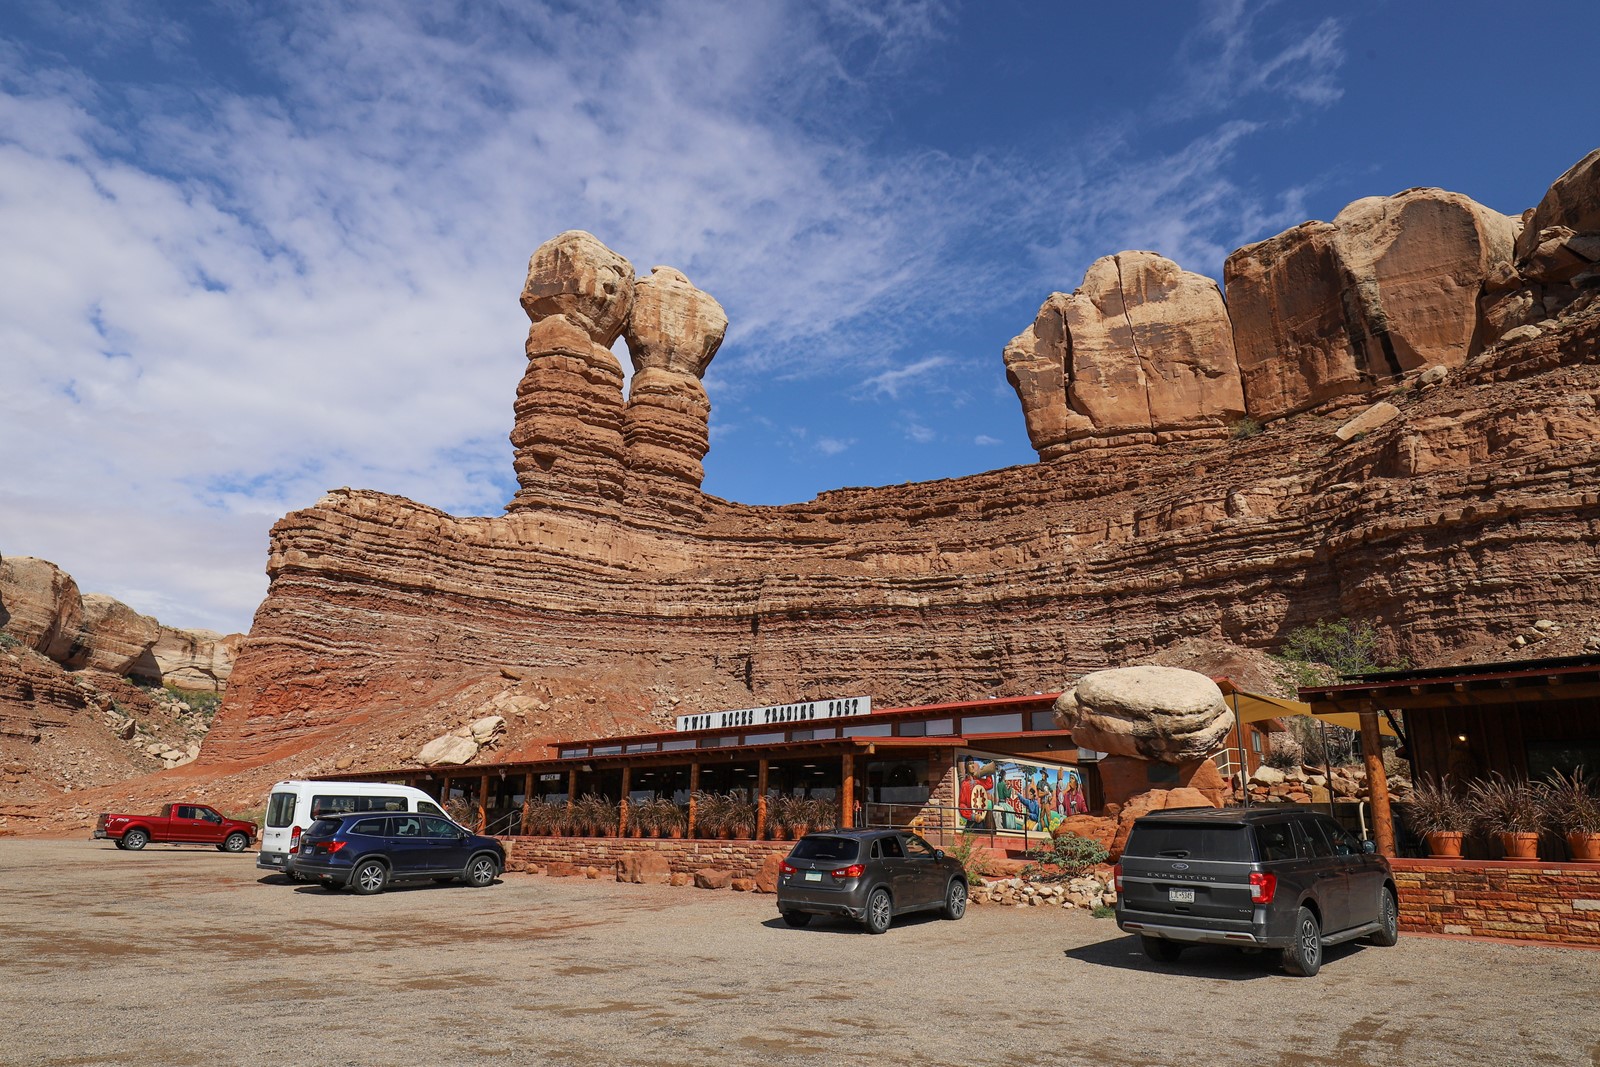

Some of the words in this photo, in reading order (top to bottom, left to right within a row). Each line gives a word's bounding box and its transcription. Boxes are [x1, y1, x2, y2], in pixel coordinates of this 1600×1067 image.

[684, 715, 711, 730] TWIN
[721, 710, 754, 727] ROCKS
[764, 703, 815, 723] TRADING
[828, 699, 858, 717] POST
[1147, 872, 1216, 881] EXPEDITION
